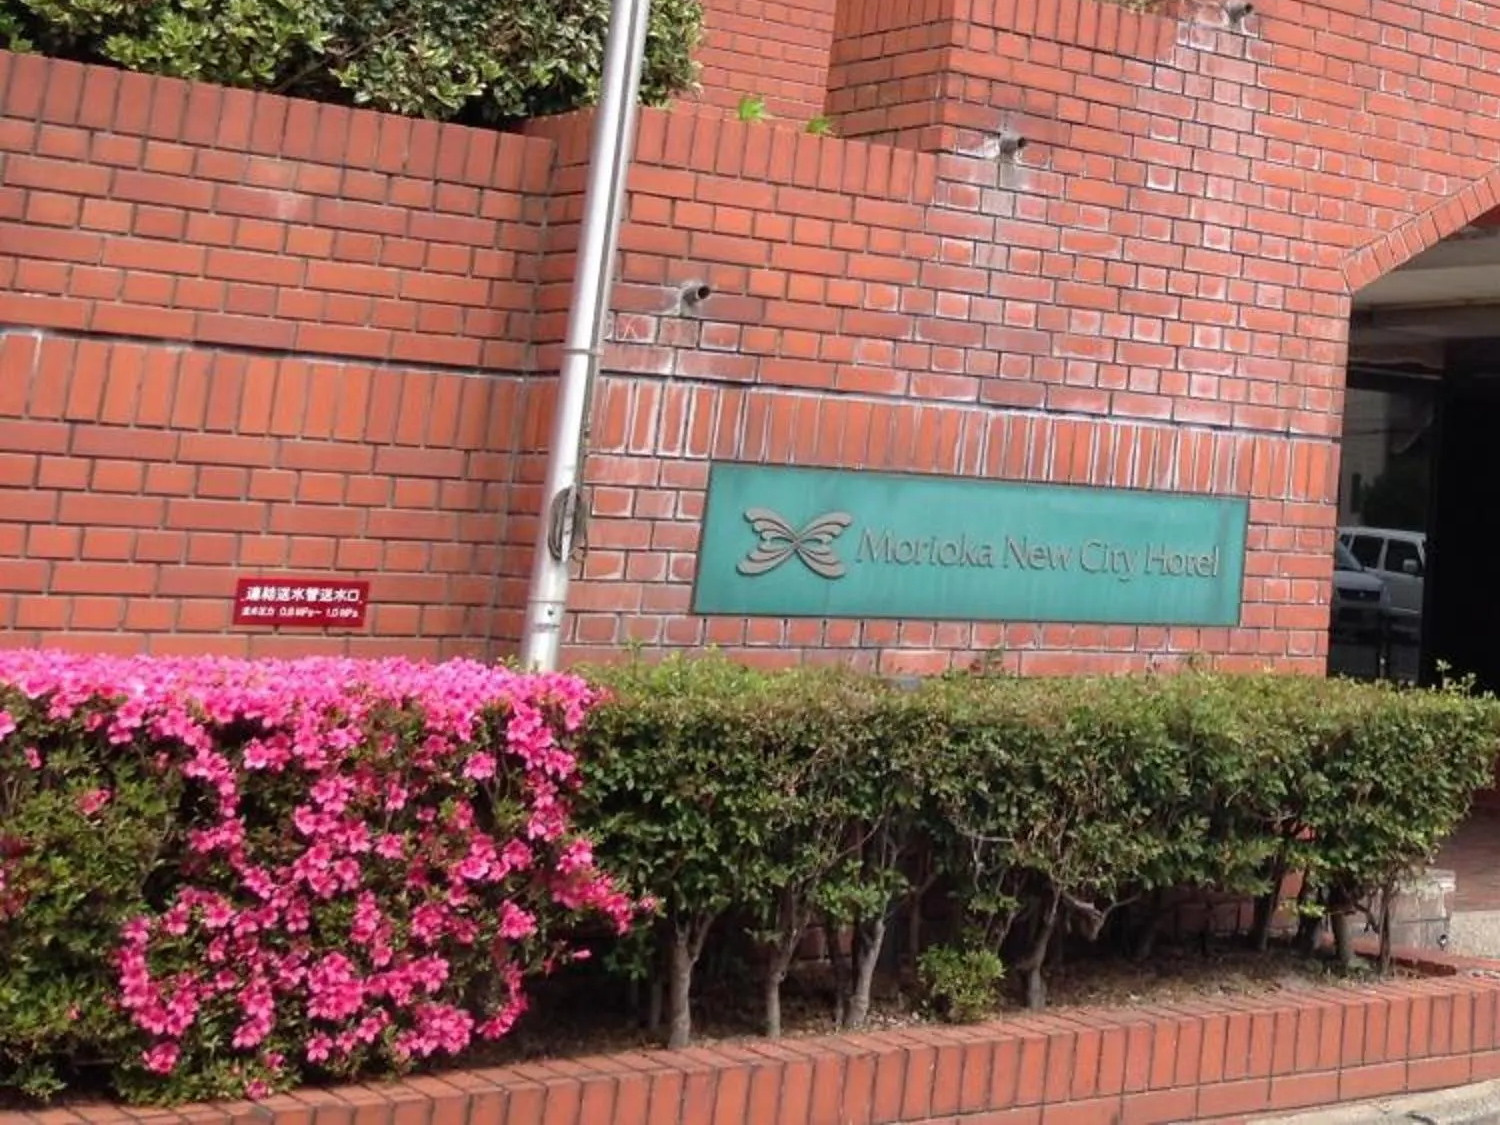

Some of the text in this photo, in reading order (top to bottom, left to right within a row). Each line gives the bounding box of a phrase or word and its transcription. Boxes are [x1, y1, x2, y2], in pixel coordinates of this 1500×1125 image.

[855, 527, 1219, 582] Morioka New City Hotel
